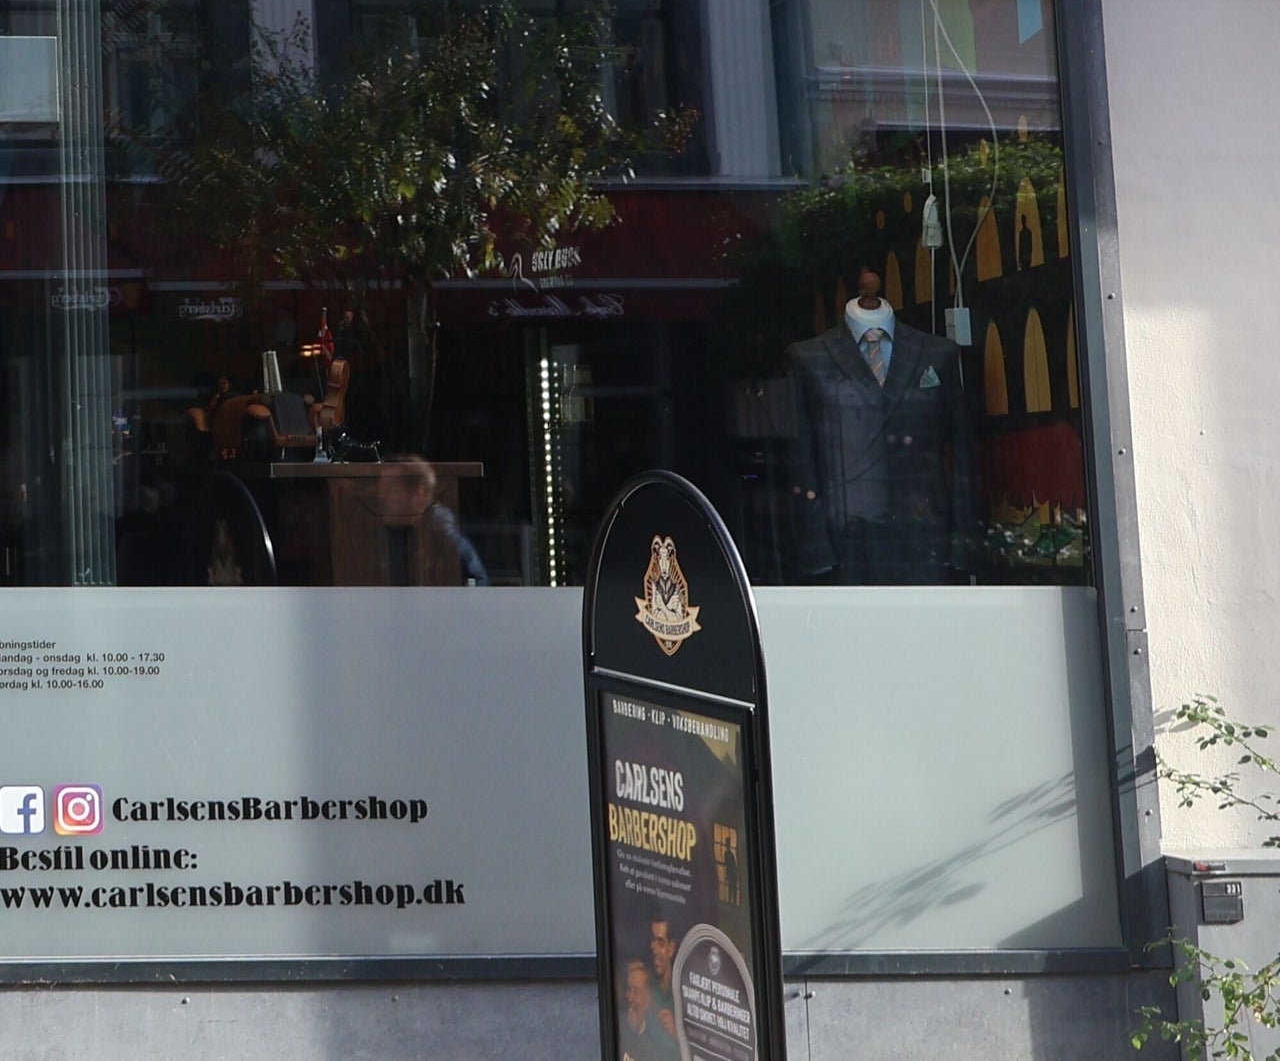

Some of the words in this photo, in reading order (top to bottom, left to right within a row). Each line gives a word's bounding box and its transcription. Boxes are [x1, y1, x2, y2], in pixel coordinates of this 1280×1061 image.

[35, 668, 49, 678] og
[51, 666, 85, 678] fredag
[87, 666, 100, 676] kl.
[103, 666, 161, 676] 10.00-19.00
[43, 653, 81, 664] onsdag
[86, 653, 99, 663] kl.
[102, 653, 128, 663] 10.00
[139, 653, 166, 663] 17.30
[31, 679, 43, 689] kl.
[46, 679, 105, 689] 10.00-16.00
[612, 699, 646, 722] BARBERING
[651, 709, 666, 727] KLIP
[671, 714, 730, 743] VOKSBEHANDLING
[615, 758, 685, 813] CARLSENS
[112, 795, 429, 824] CarlsensBarbershop
[608, 802, 697, 862] BARBERSHOP
[89, 844, 199, 871] online:
[0, 879, 467, 909] www.carlsensbarbershop.dk
